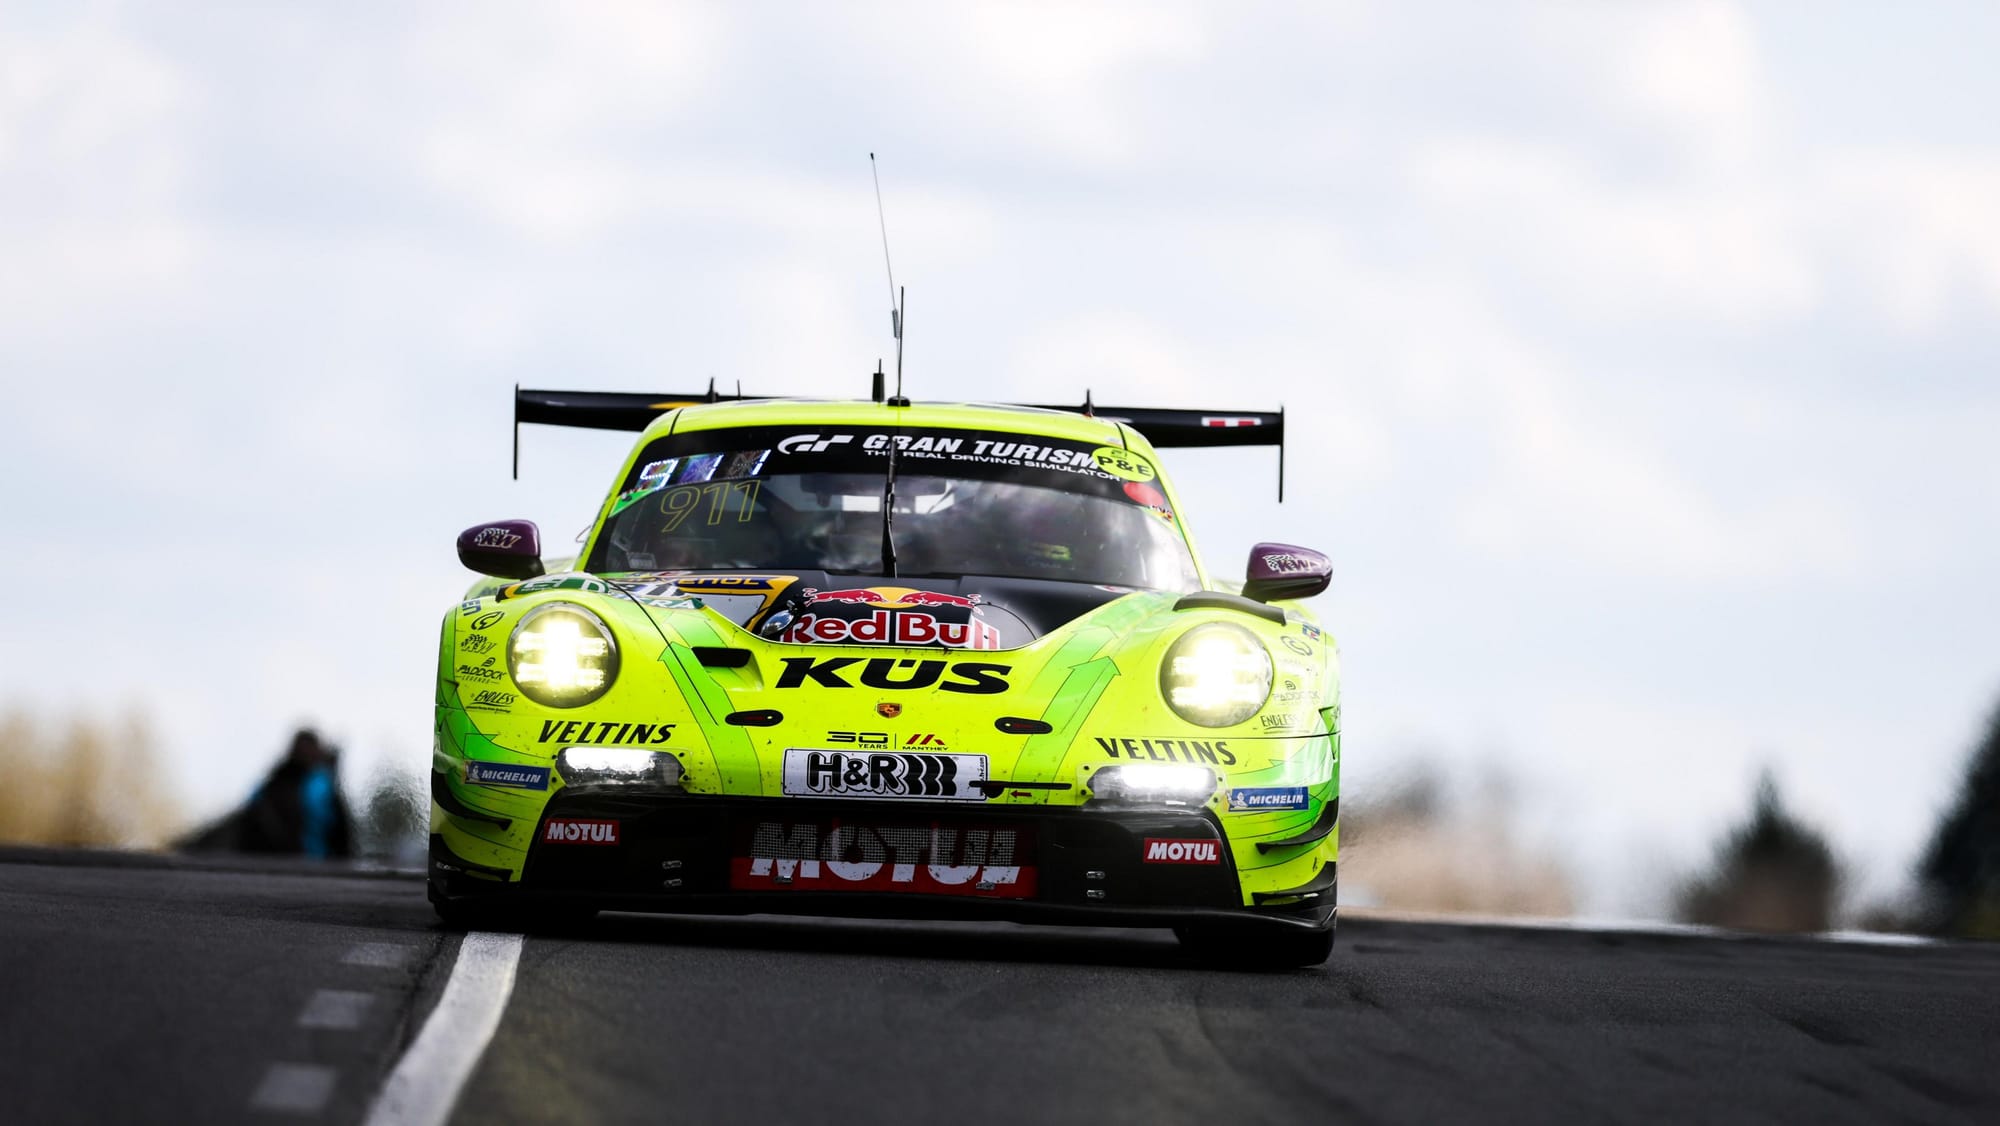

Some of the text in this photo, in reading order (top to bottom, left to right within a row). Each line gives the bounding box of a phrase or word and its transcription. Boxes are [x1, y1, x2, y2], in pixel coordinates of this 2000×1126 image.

[863, 434, 1098, 469] GRAN TURISM
[903, 452, 946, 460] REAL
[951, 454, 1021, 466] DRIVING
[1024, 460, 1121, 482] SIMULATOR
[1096, 455, 1154, 478] P&E
[660, 480, 761, 533] 911
[777, 610, 890, 645] Red
[457, 664, 507, 681] PADDOCK
[775, 657, 1013, 695] KÜS
[473, 689, 518, 705] ENDLESS
[537, 720, 676, 744] VELTINS
[827, 731, 888, 743] 30
[1095, 737, 1237, 766] VELTINS
[481, 770, 542, 785] MICHELIN
[807, 752, 906, 795] H&R
[1249, 793, 1304, 806] MICHELIN
[547, 823, 616, 843] MOTUL
[750, 822, 1021, 886] MOTUL
[1147, 842, 1217, 862] MOTUL
